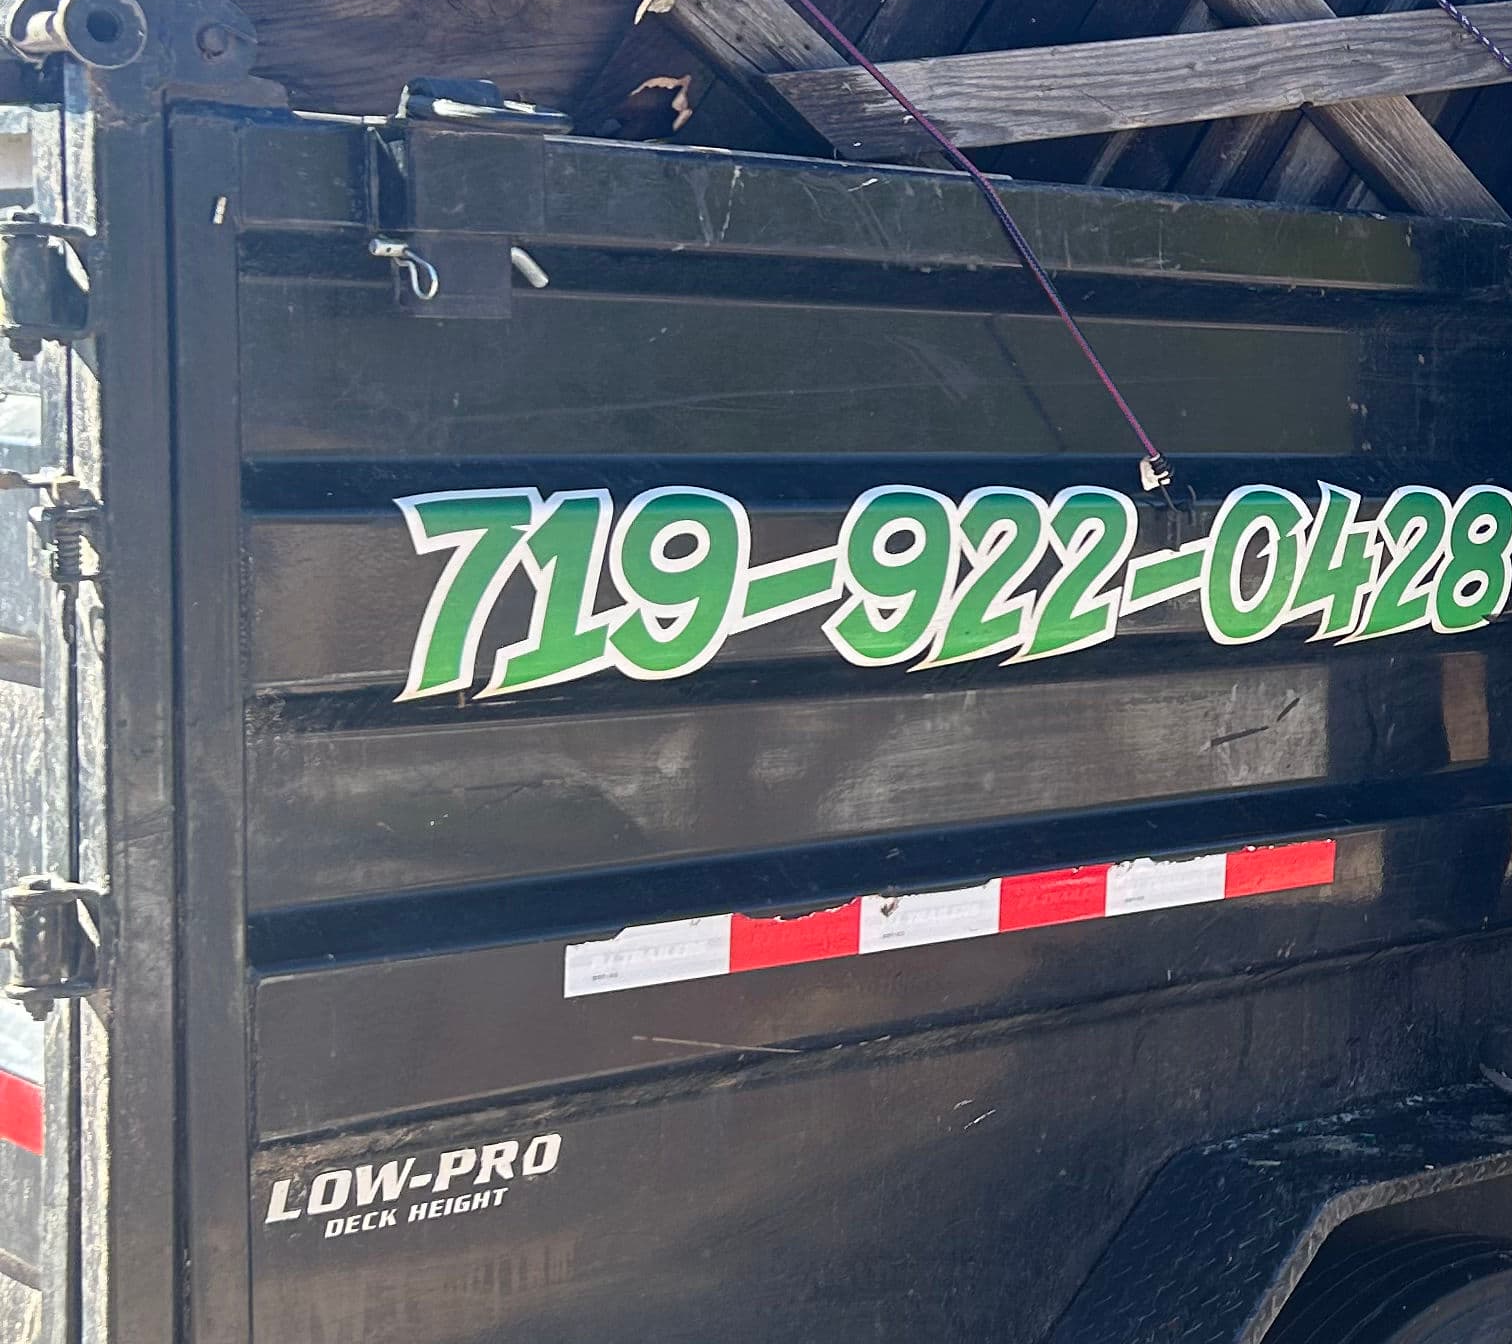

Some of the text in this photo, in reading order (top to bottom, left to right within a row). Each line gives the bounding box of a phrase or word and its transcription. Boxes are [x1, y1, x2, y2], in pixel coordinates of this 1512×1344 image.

[264, 1133, 562, 1225] LOW-PRO
[324, 1187, 510, 1239] DECK HEIGHT
